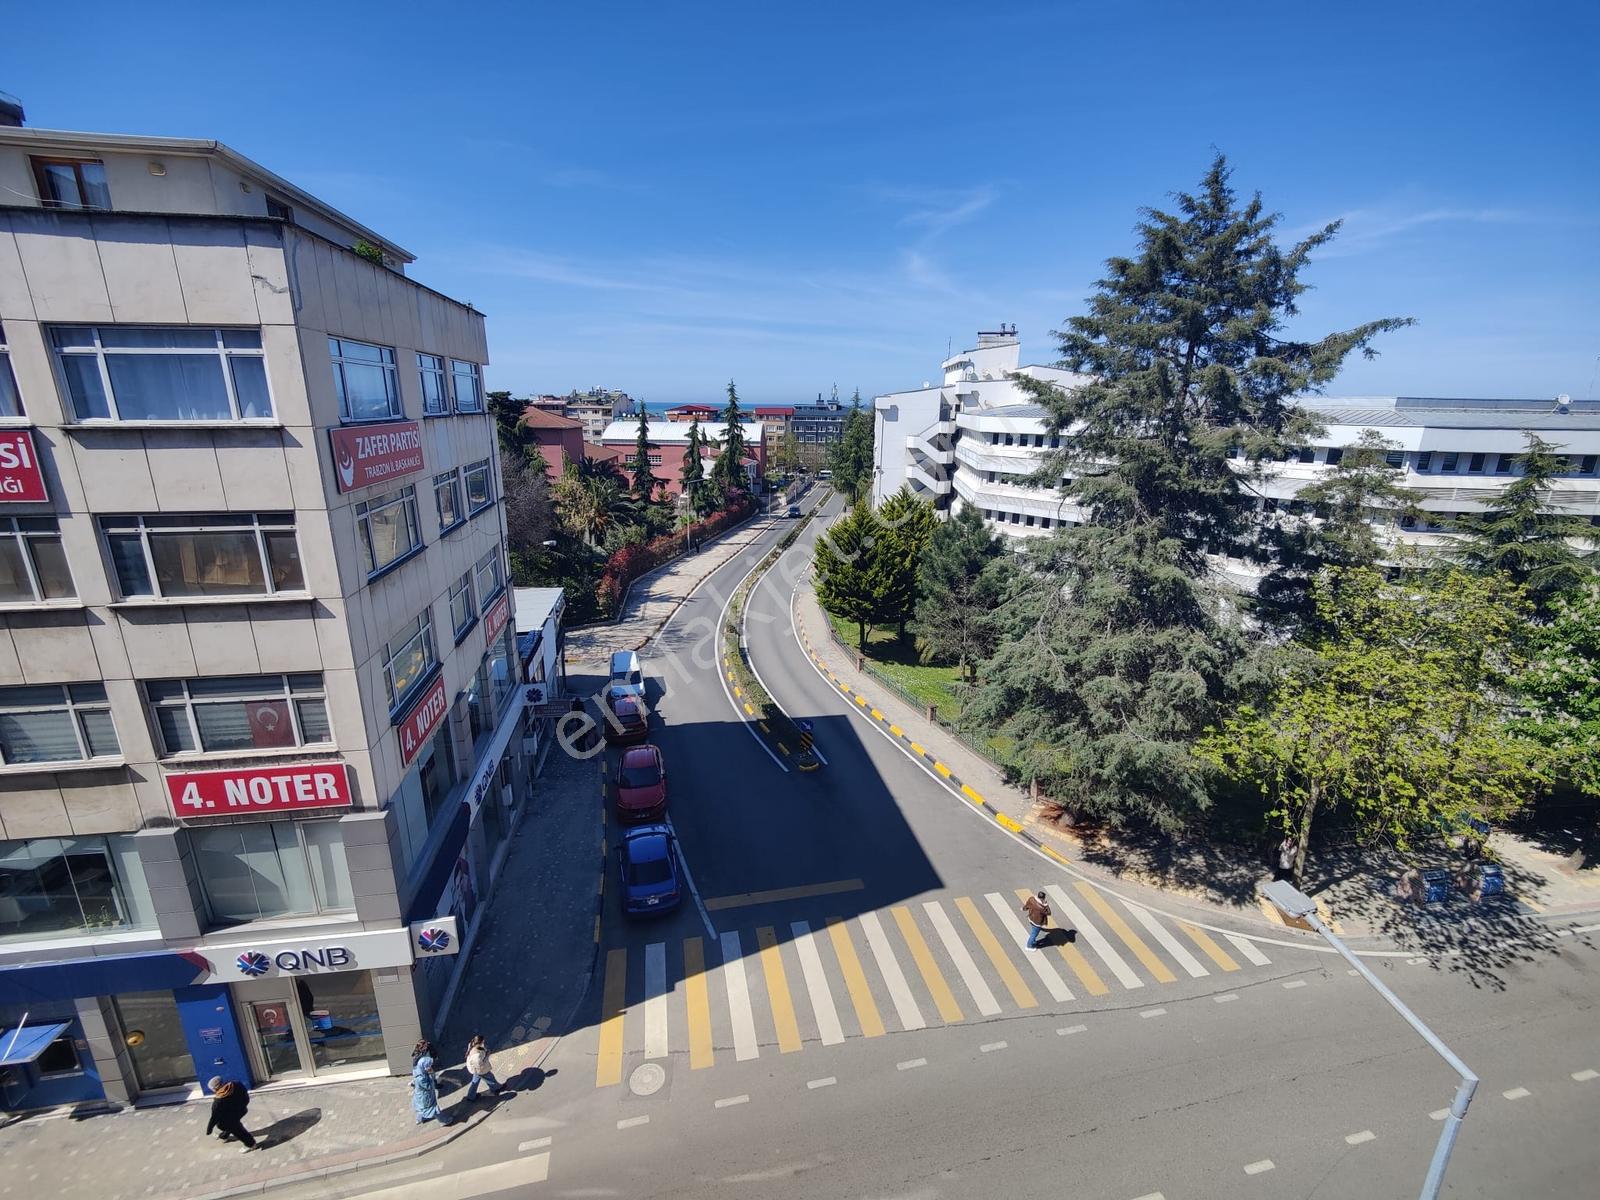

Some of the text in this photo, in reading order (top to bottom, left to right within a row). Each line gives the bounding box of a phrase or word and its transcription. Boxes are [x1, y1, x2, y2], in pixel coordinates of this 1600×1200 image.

[355, 434, 390, 459] ZAFER
[364, 463, 391, 479] TRABZON
[406, 686, 444, 751] 4. NOTER
[481, 759, 495, 791] QNB
[181, 772, 340, 809] 4. NOTER
[275, 946, 350, 971] QNB
